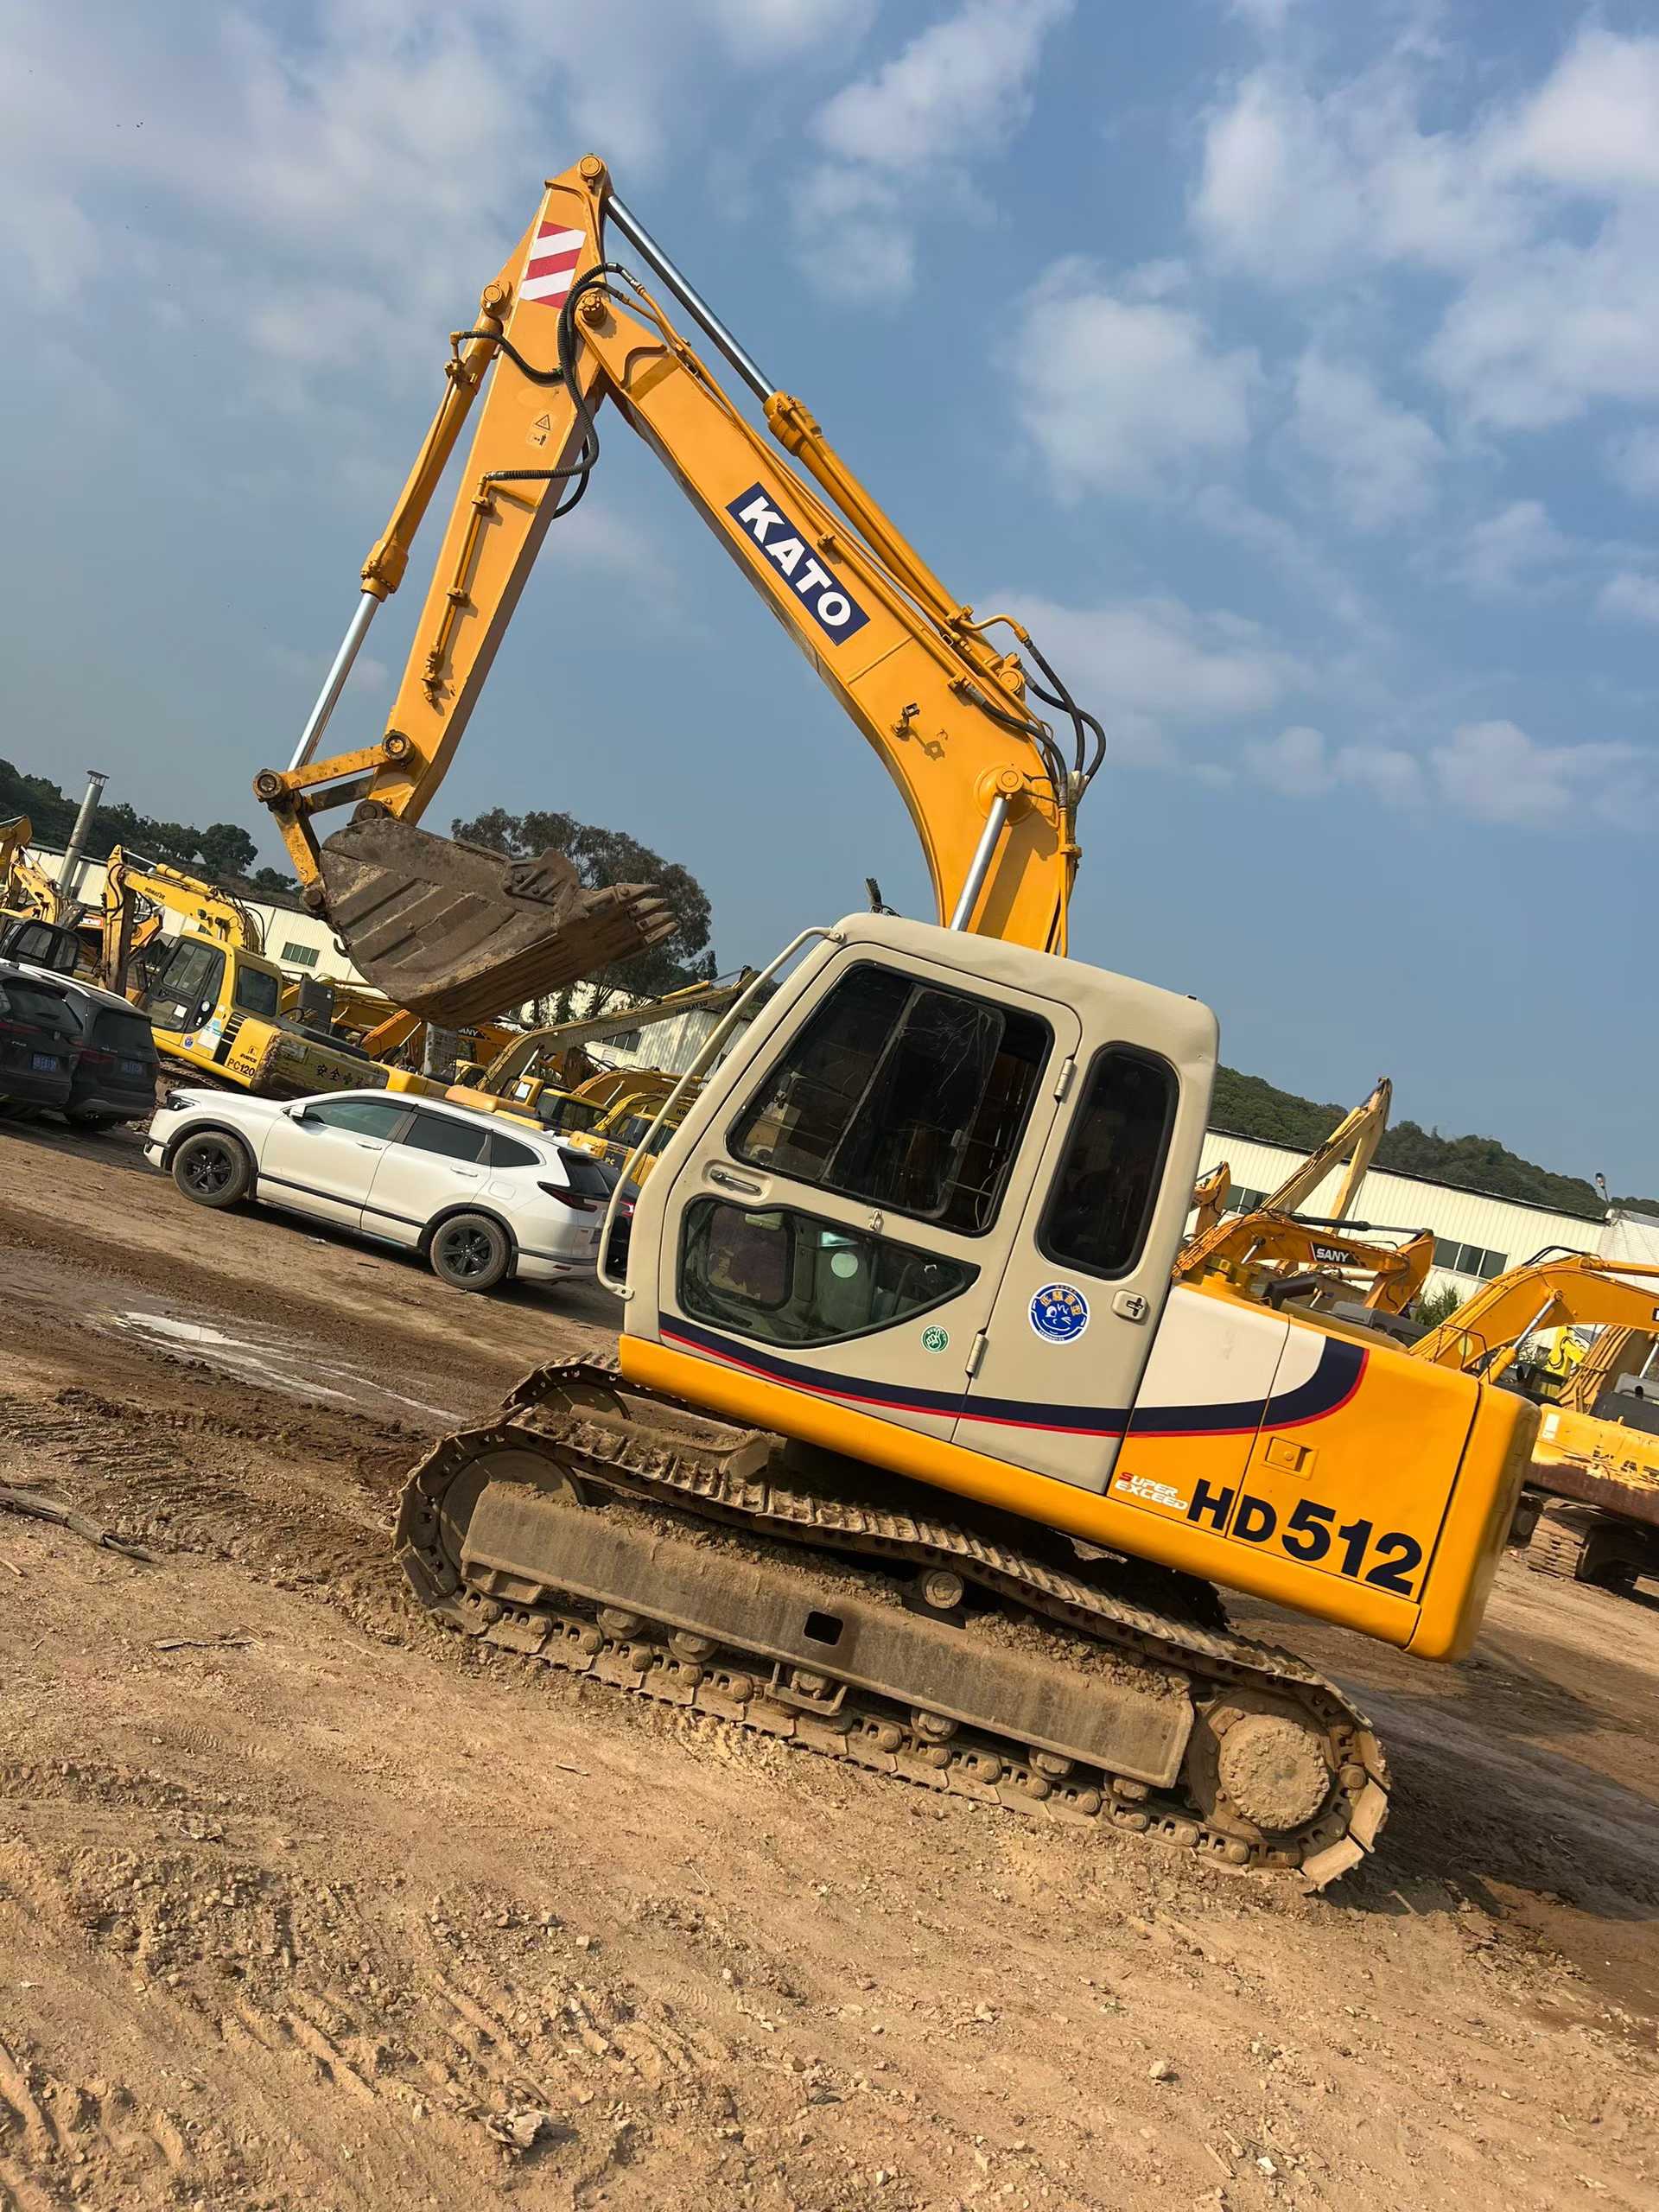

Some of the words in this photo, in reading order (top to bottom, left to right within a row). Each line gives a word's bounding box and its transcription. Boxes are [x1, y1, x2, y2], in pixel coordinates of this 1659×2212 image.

[739, 495, 851, 626] KATO
[226, 1058, 256, 1077] PC120
[1316, 1248, 1349, 1262] SANY
[1115, 1479, 1189, 1510] EXCEED
[1119, 1471, 1179, 1497] SUPER
[1186, 1478, 1423, 1596] HD512
